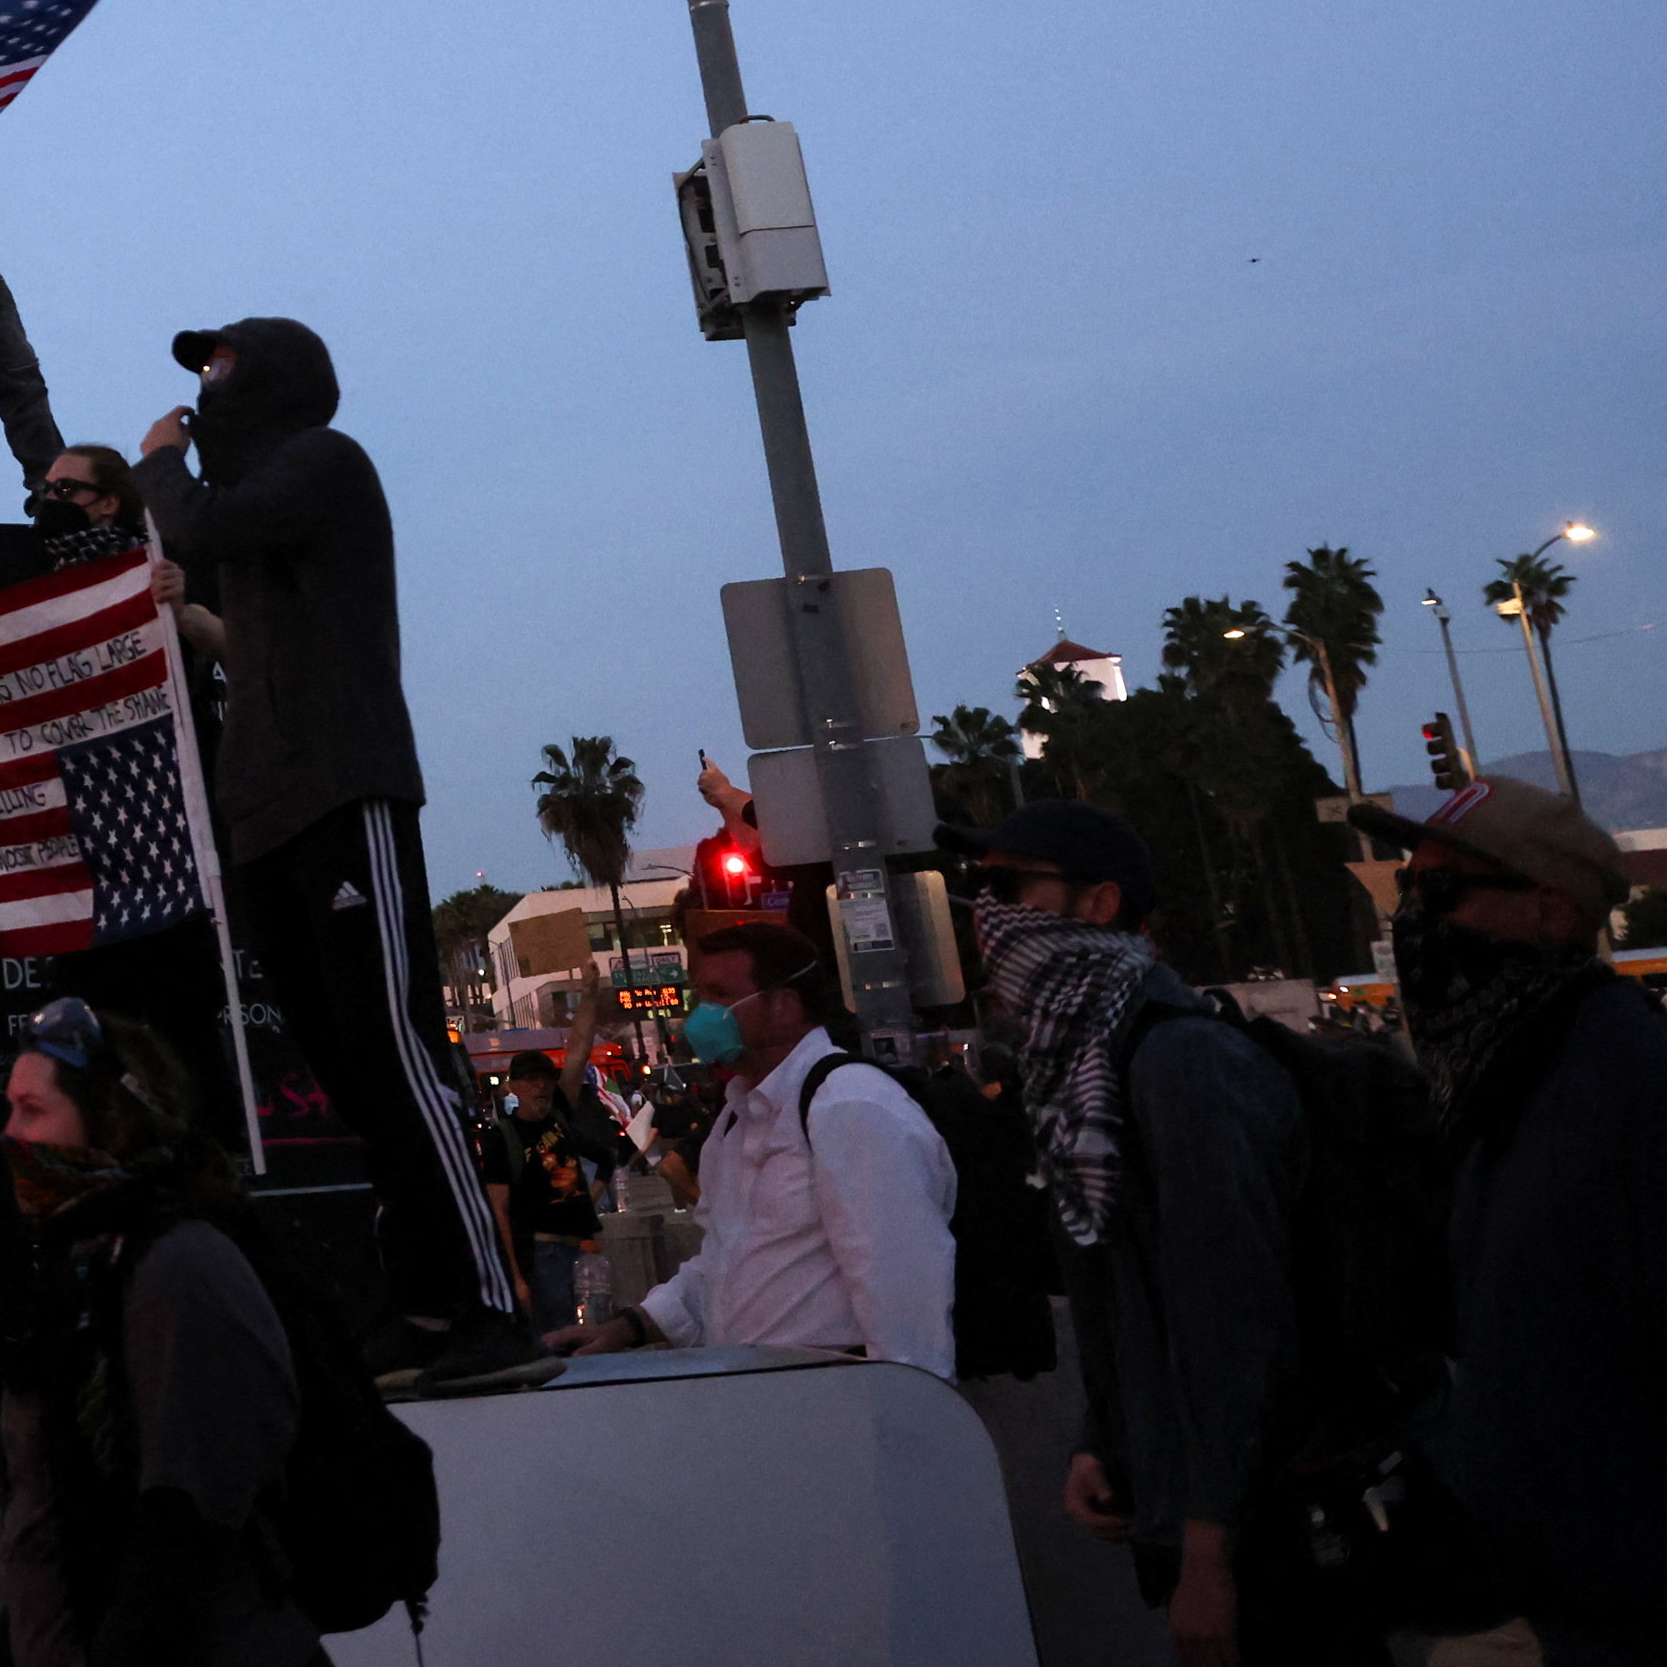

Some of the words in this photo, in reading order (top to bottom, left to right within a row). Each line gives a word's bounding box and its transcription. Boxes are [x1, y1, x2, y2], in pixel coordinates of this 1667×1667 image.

[15, 667, 45, 692] NO
[45, 655, 93, 688] FLAG
[95, 631, 147, 670] LARGE
[5, 729, 33, 750] TO
[40, 714, 93, 745] COVER
[94, 703, 124, 725] THE
[123, 684, 171, 720] SHAME
